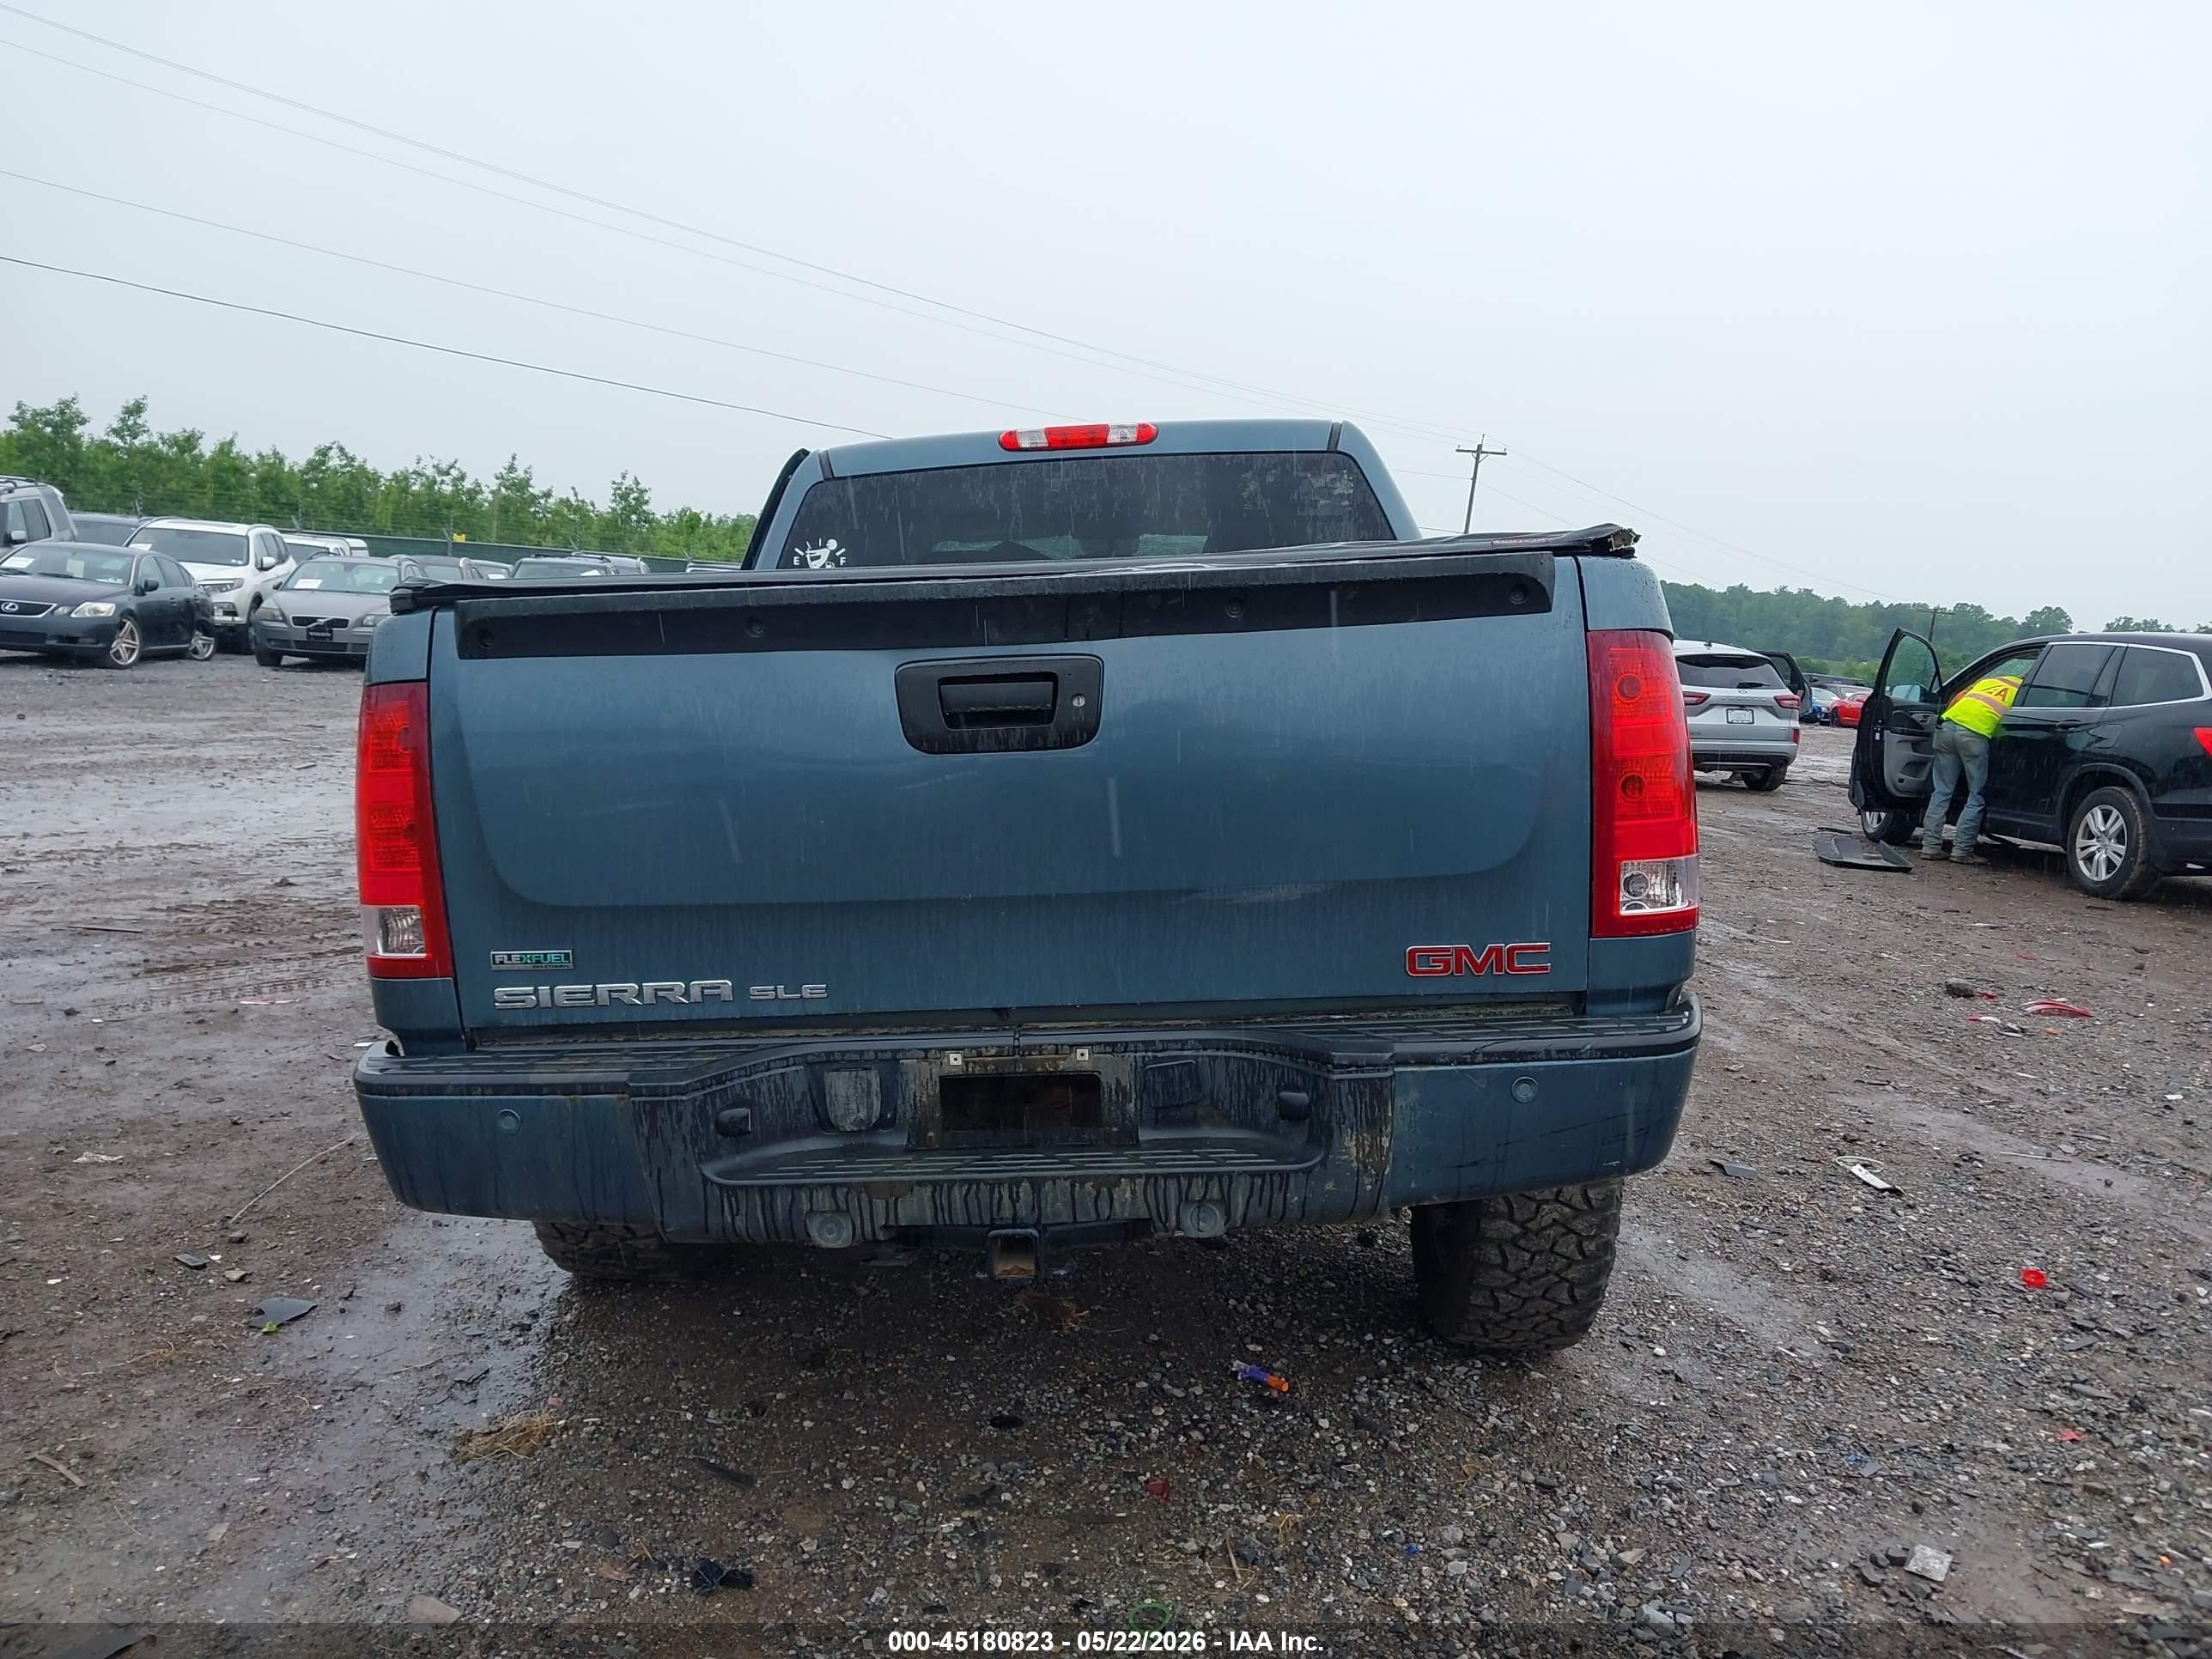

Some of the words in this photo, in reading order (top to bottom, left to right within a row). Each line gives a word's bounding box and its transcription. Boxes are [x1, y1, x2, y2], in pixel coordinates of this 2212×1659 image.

[793, 556, 800, 566] E
[840, 556, 847, 566] F
[494, 953, 570, 964] FLEXFUEL
[1405, 942, 1552, 977] GMC
[493, 979, 734, 1010] SIERRA
[748, 983, 829, 1000] SLE
